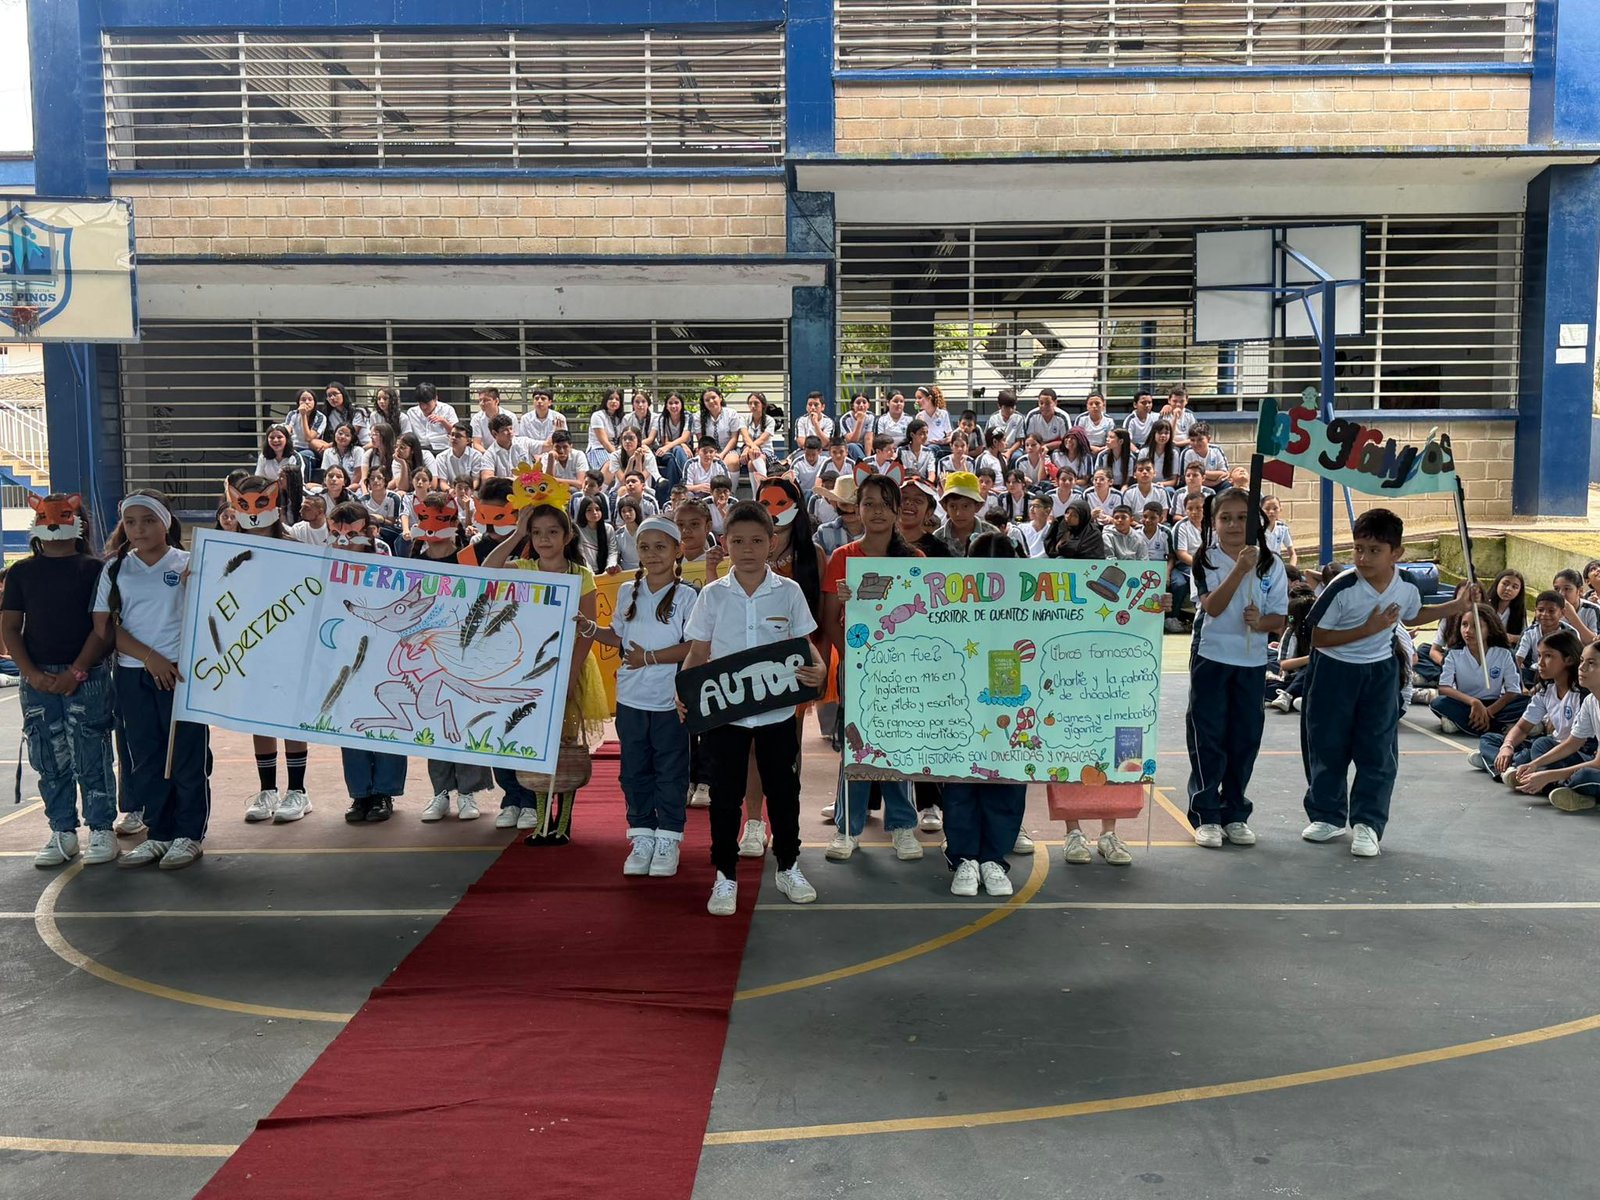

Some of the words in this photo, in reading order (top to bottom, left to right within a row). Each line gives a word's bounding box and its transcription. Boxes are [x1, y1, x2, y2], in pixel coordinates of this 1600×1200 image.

[17, 292, 56, 302] PINOS
[329, 561, 466, 598] LITERATURA
[478, 578, 562, 606] INFANTIL
[923, 572, 1005, 608] ROALD
[1019, 572, 1087, 604] DAHL
[216, 591, 240, 622] El
[926, 610, 970, 624] ESCRITOR
[975, 610, 985, 621] DE
[990, 608, 1029, 621] CUENTOS
[1032, 608, 1084, 621] INFANTILES
[194, 577, 323, 691] Superzorro
[910, 645, 941, 662] fue?
[700, 654, 805, 717] AUTOR
[904, 675, 917, 683] en
[921, 672, 940, 683] 1916
[942, 672, 956, 681] en
[1054, 669, 1088, 688] Charlie
[1092, 675, 1098, 691] y
[1106, 668, 1117, 684] la
[875, 683, 920, 700] Inglaterra
[1060, 688, 1072, 700] de
[1080, 686, 1130, 700] chocolate
[891, 697, 917, 714] piloto
[918, 701, 924, 713] y
[926, 693, 966, 707] escritor
[874, 715, 884, 727] Es
[887, 719, 926, 730] famoso
[929, 719, 944, 730] por
[948, 718, 968, 727] sus
[1057, 712, 1092, 723] James
[1095, 714, 1101, 725] y
[1104, 707, 1112, 721] el
[917, 727, 968, 739] divertidos
[1063, 721, 1103, 740] gigante
[918, 752, 965, 766] HISTORIAS
[968, 750, 987, 762] SON
[991, 749, 1044, 762] DIVERTIDAS
